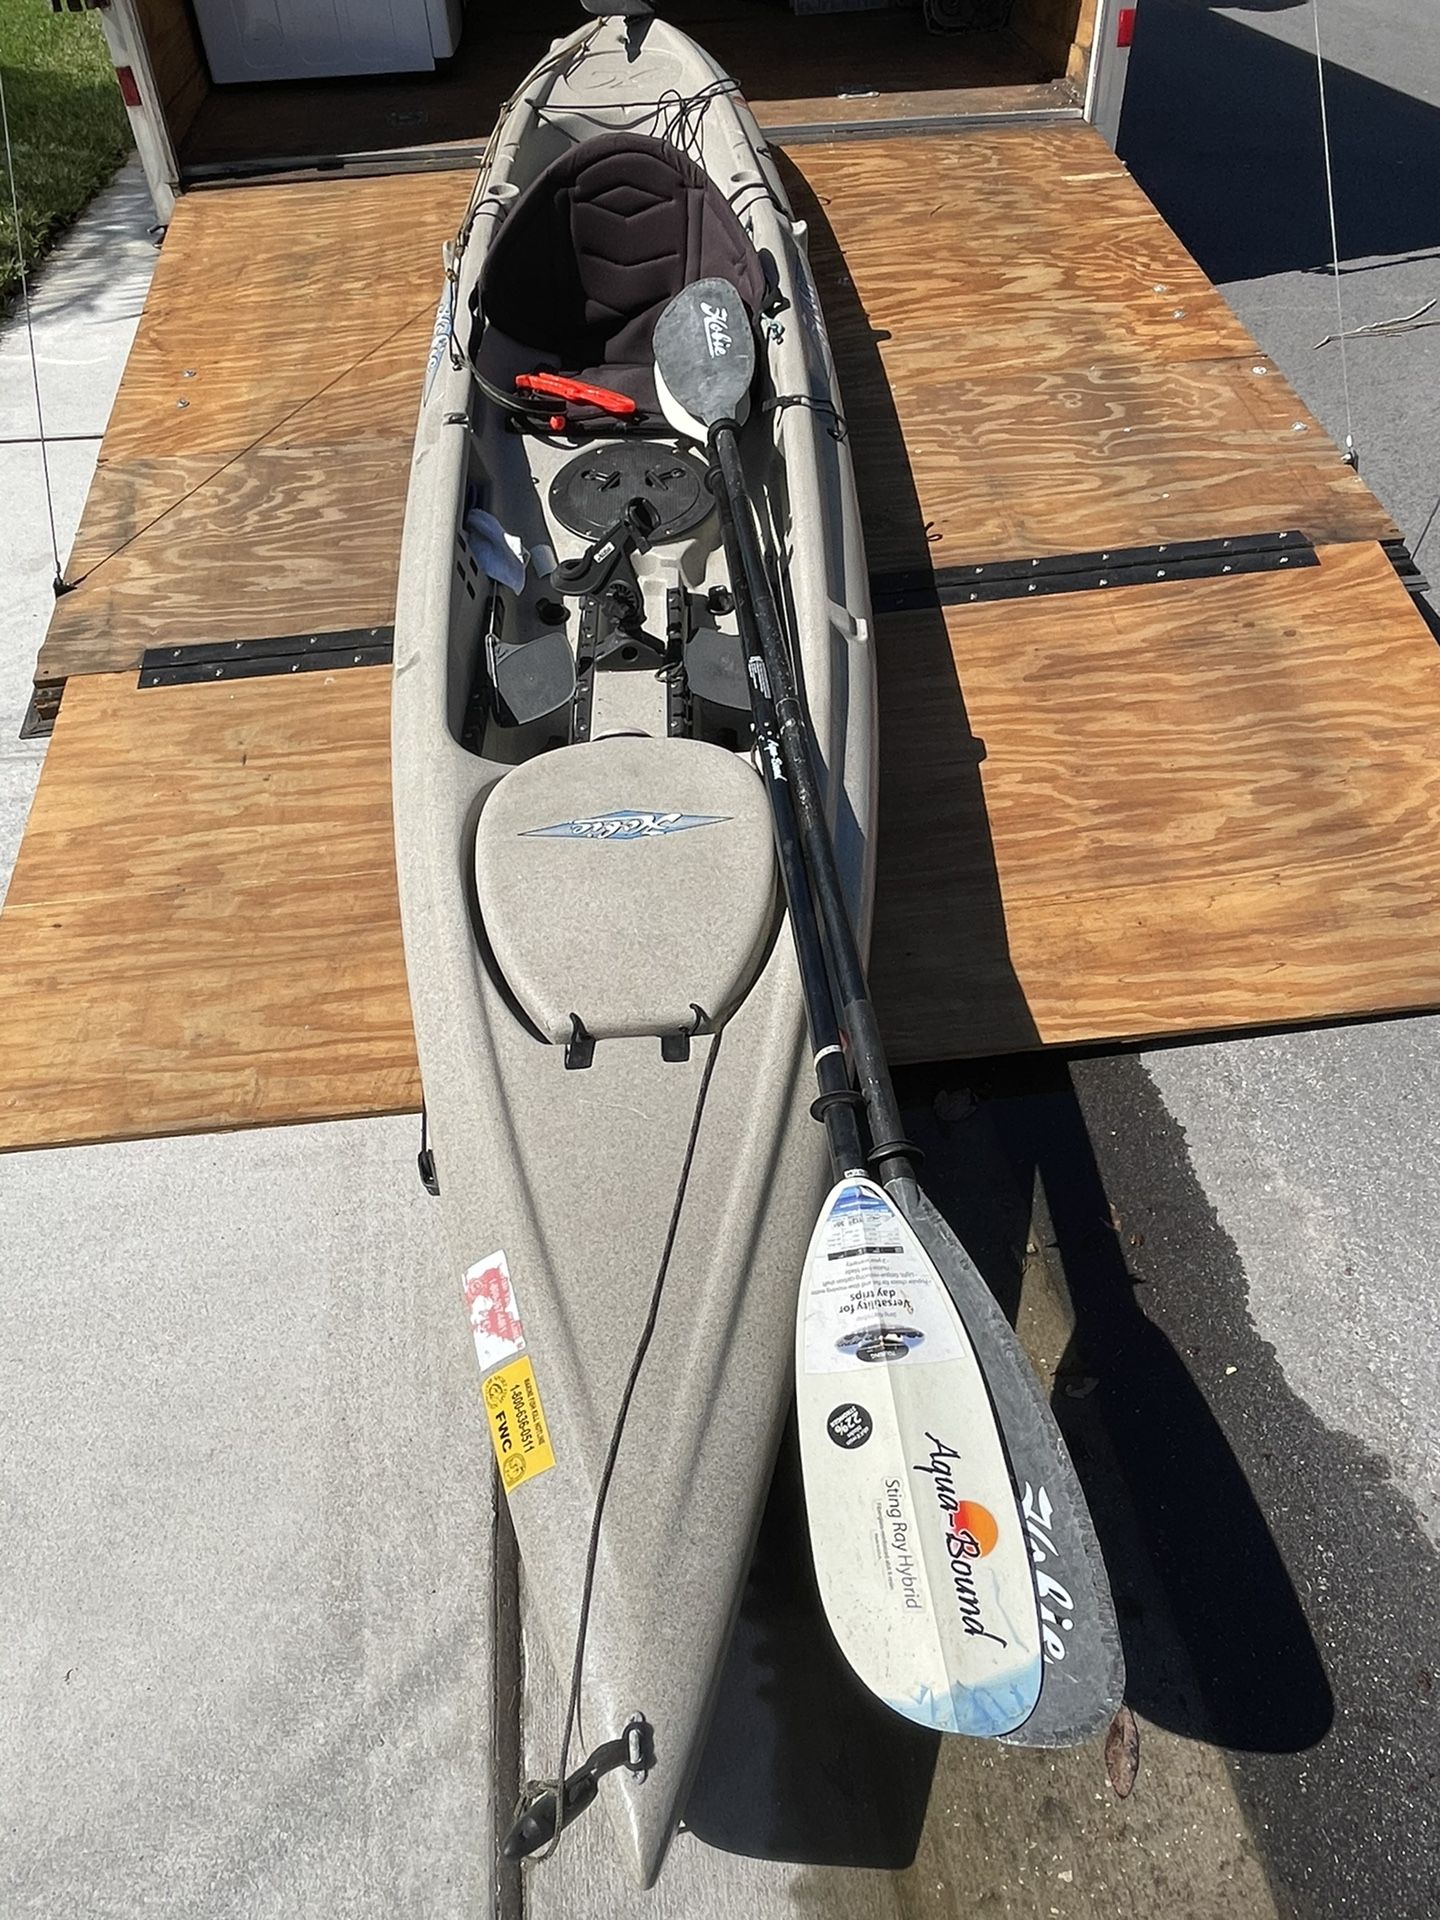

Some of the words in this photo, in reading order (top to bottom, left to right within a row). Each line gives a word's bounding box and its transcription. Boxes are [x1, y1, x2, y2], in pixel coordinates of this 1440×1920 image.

[700, 302, 732, 359] Hobie
[570, 814, 682, 839] Hobie
[849, 1288, 874, 1302] trips
[857, 1298, 910, 1312] Versatility
[876, 1286, 895, 1298] day
[838, 1303, 854, 1314] for
[496, 1410, 512, 1453] FWC
[509, 1383, 534, 1452] 1-800-636-0511
[834, 1410, 862, 1436] 22%
[884, 1478, 902, 1518] Sting
[891, 1521, 908, 1552] Ray
[913, 1432, 1007, 1648] Aqua-Bound
[896, 1553, 921, 1610] Hybrid
